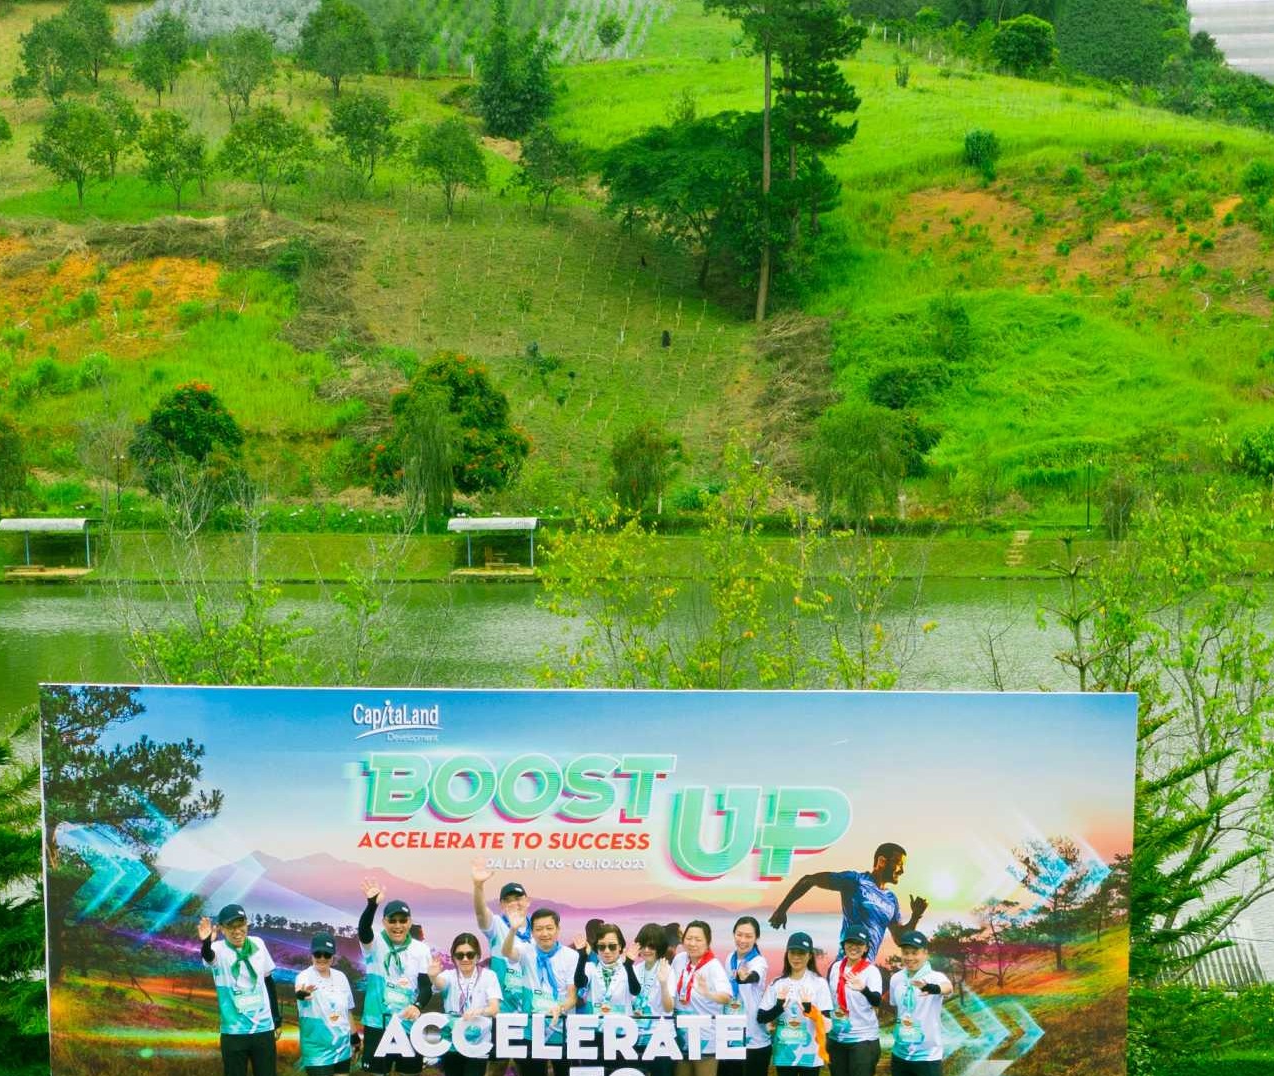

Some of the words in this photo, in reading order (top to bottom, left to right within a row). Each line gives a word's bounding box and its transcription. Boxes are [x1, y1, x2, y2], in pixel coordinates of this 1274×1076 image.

[353, 700, 439, 729] CapitaLand
[363, 752, 677, 824] BOOST
[358, 831, 504, 850] ACCELERATE
[511, 831, 543, 850] TO
[547, 832, 650, 850] SUCCESS
[668, 785, 853, 881] UP
[374, 1011, 747, 1062] ACCELERATE
